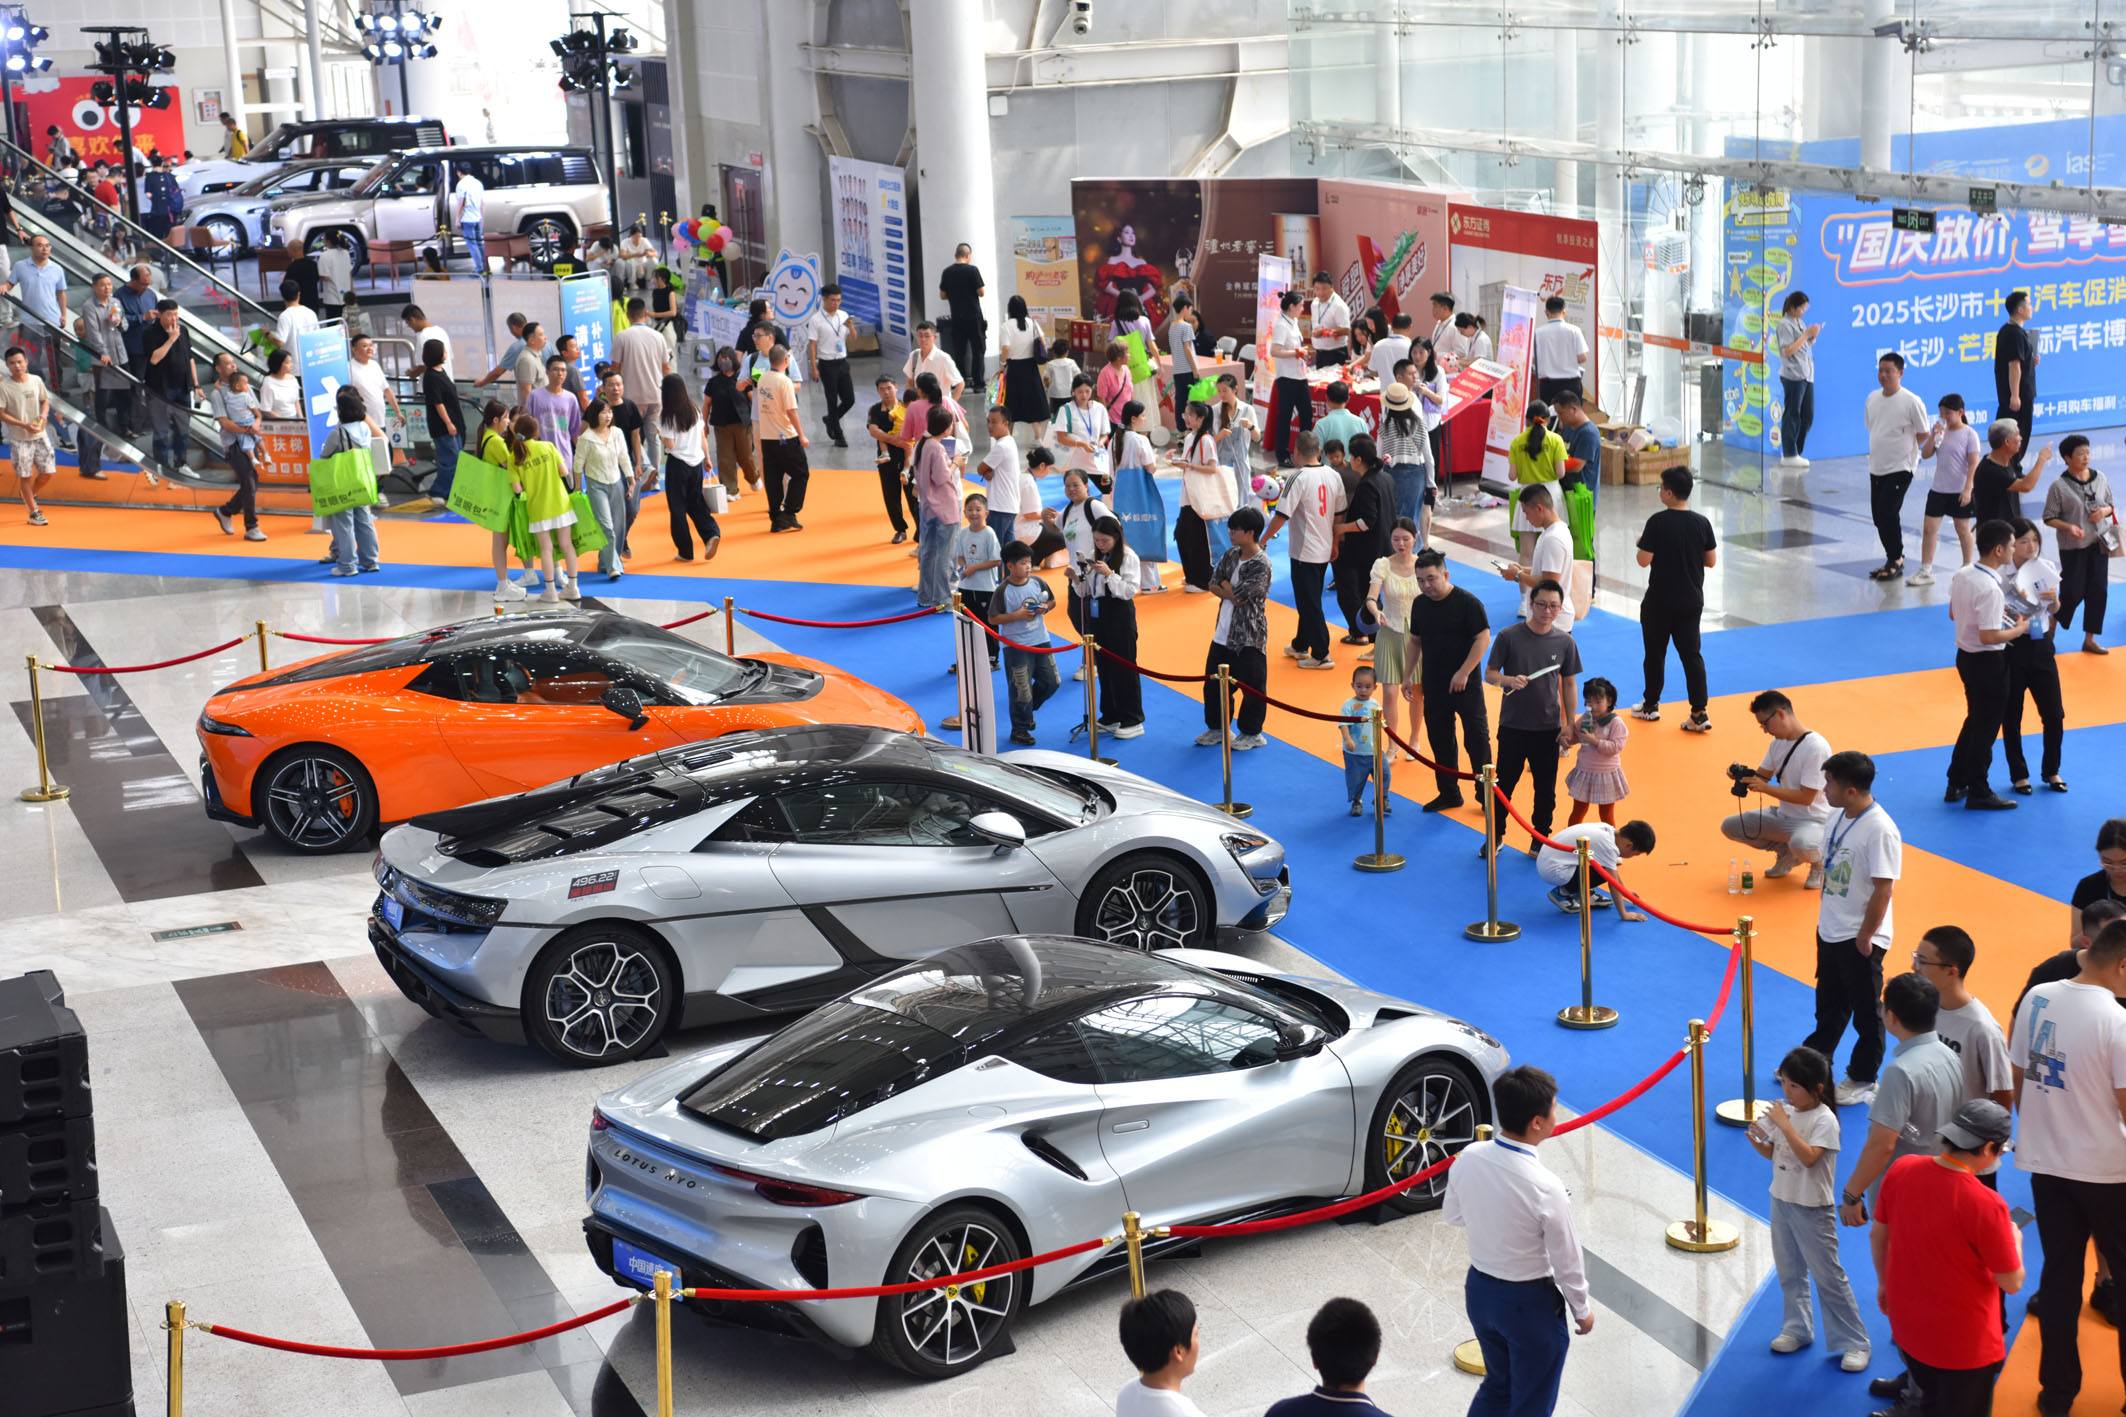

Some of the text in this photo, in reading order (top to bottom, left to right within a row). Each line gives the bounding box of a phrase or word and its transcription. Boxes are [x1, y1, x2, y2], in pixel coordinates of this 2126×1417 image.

[591, 321, 604, 360] 补贴
[273, 437, 304, 453] 扶梯
[1318, 484, 1327, 517] 9
[572, 872, 614, 887] 496.22
[614, 1149, 658, 1174] LOTUS
